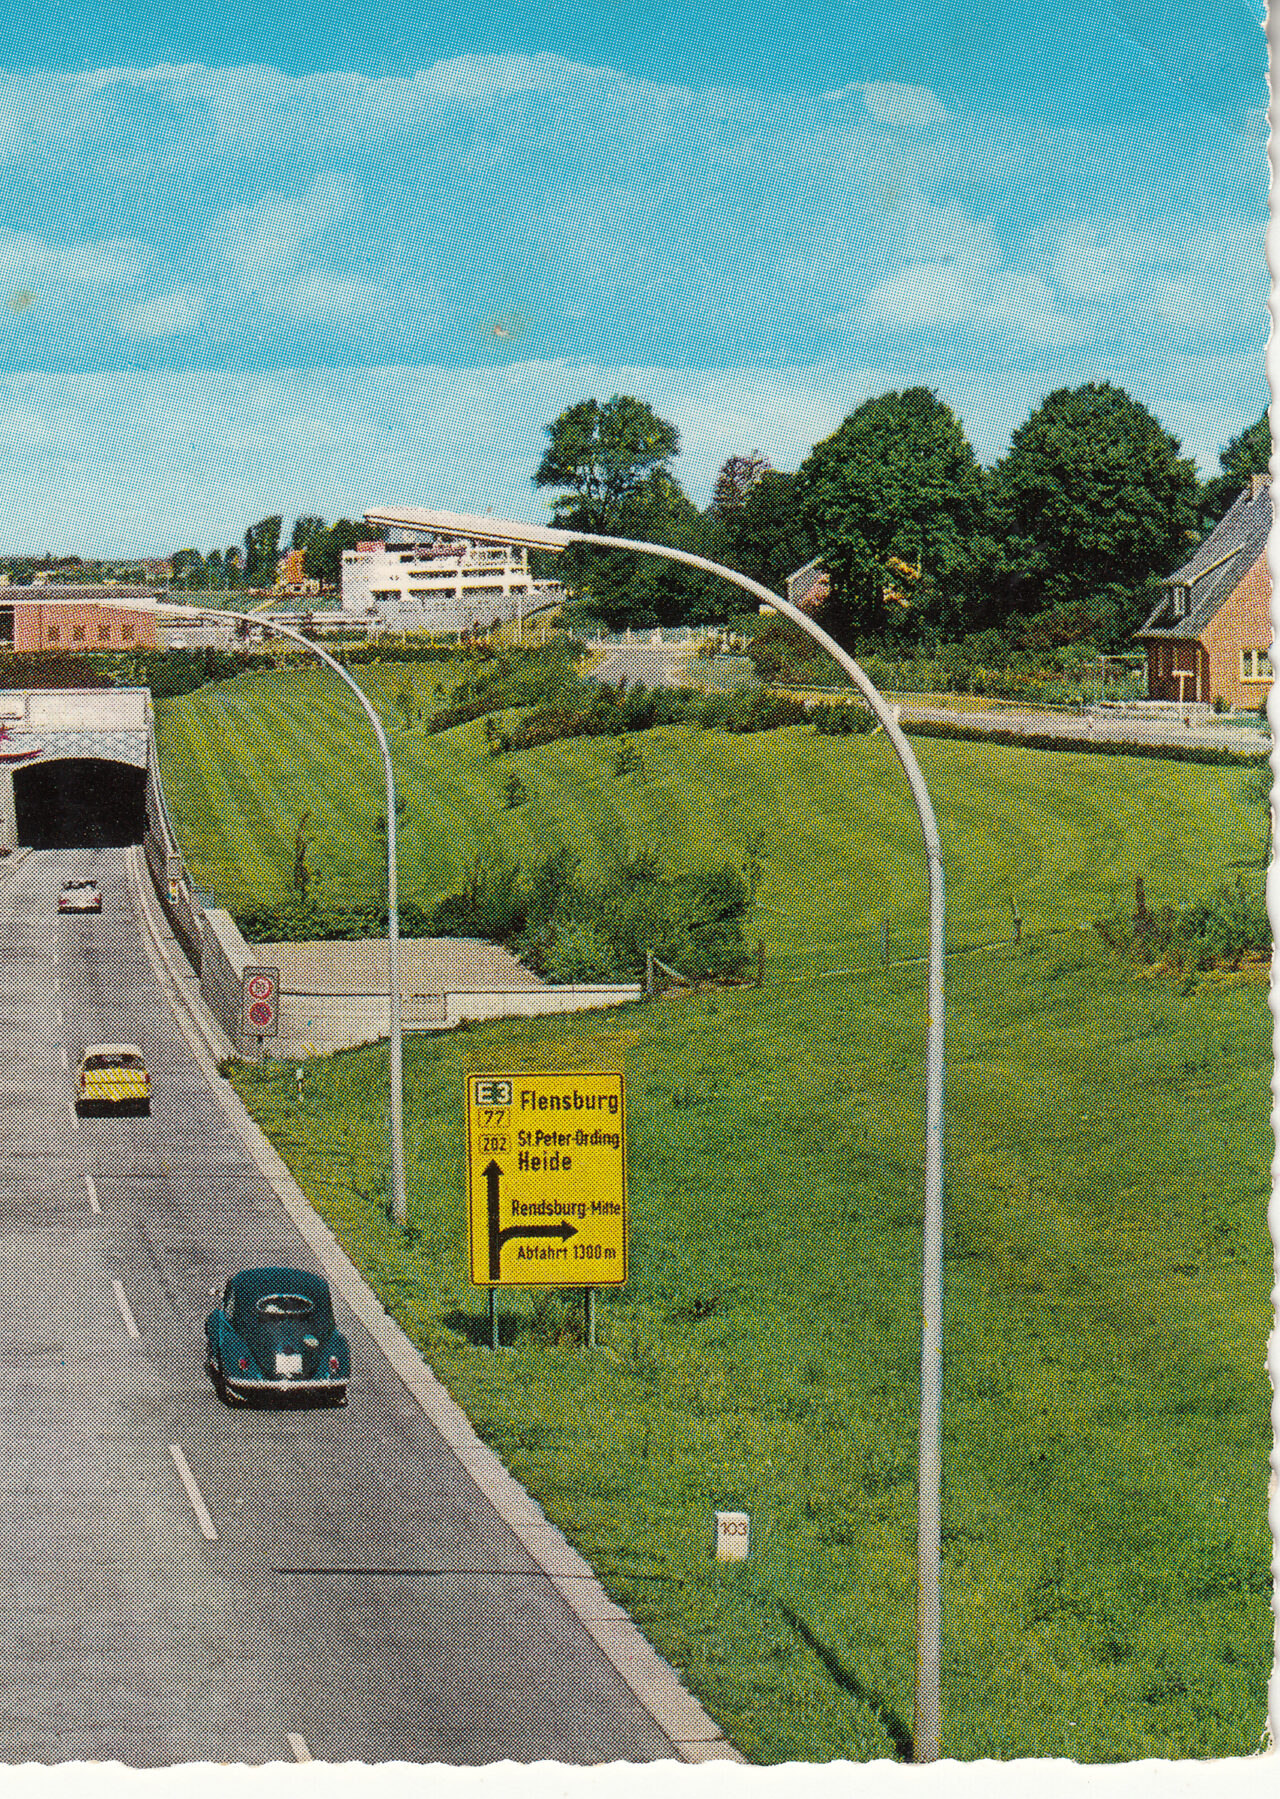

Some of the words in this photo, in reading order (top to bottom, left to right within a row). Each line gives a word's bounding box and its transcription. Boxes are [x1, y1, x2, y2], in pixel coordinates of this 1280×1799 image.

[477, 1082, 511, 1104] E3
[520, 1090, 619, 1115] Flensburg
[483, 1111, 505, 1126] 77
[483, 1137, 507, 1151] 202
[518, 1151, 572, 1171] Heide
[511, 1199, 621, 1219] Rendsburg-Mitte
[517, 1245, 568, 1260] Abfahrt
[720, 1521, 747, 1536] 103
